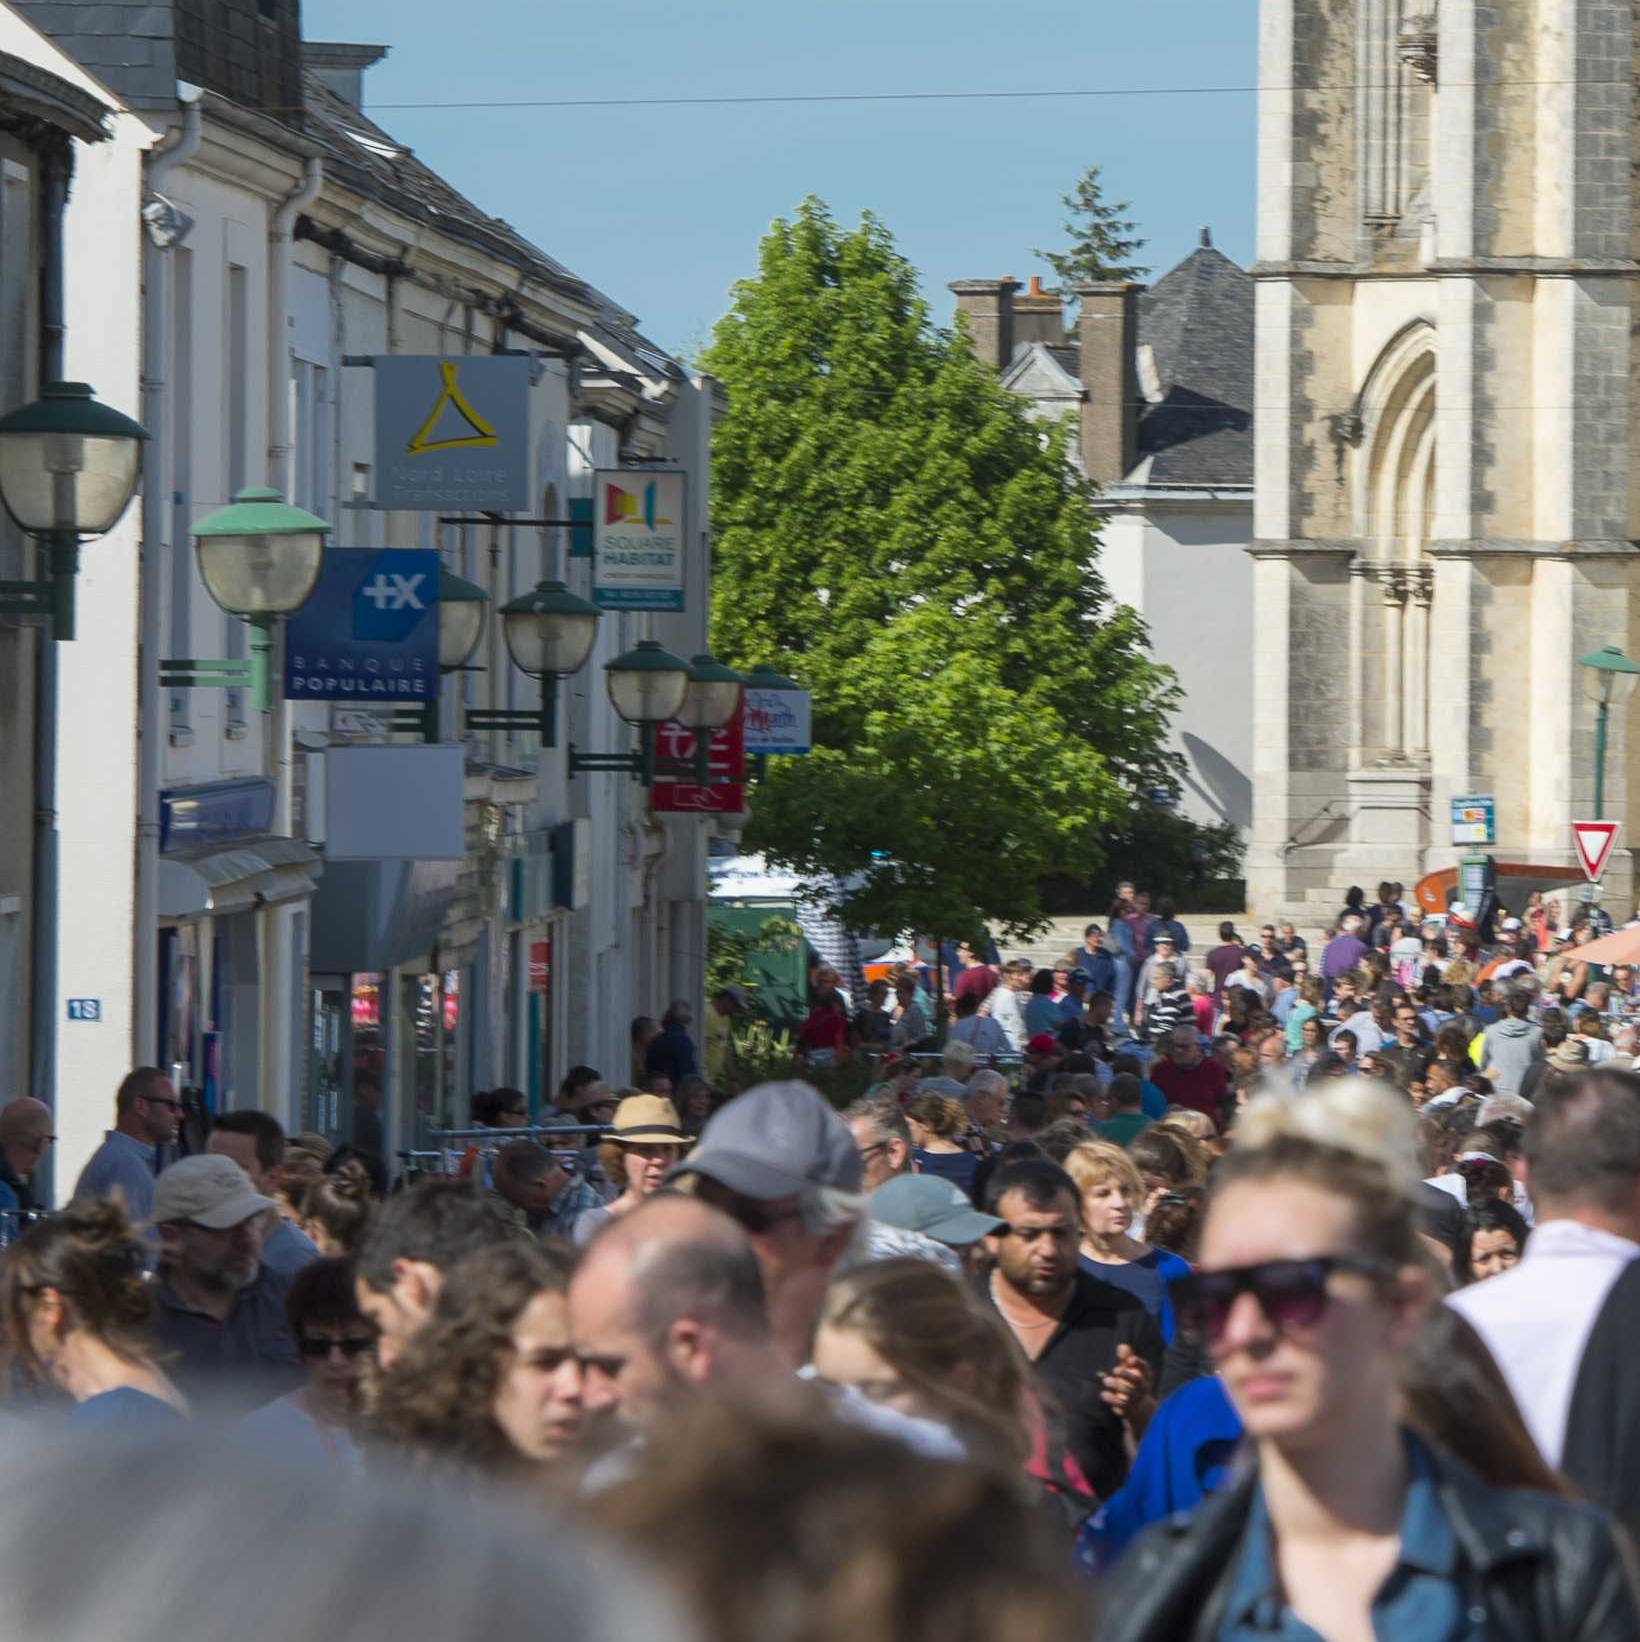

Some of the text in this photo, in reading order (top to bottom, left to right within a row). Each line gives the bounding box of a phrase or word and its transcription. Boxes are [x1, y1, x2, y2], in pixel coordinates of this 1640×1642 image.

[390, 466, 443, 482] Nord
[603, 535, 675, 551] SQUARE
[603, 551, 675, 566] HABITAT
[292, 656, 426, 673] BANQUE
[292, 676, 427, 693] POPULAIRE
[70, 1000, 98, 1019] 18
